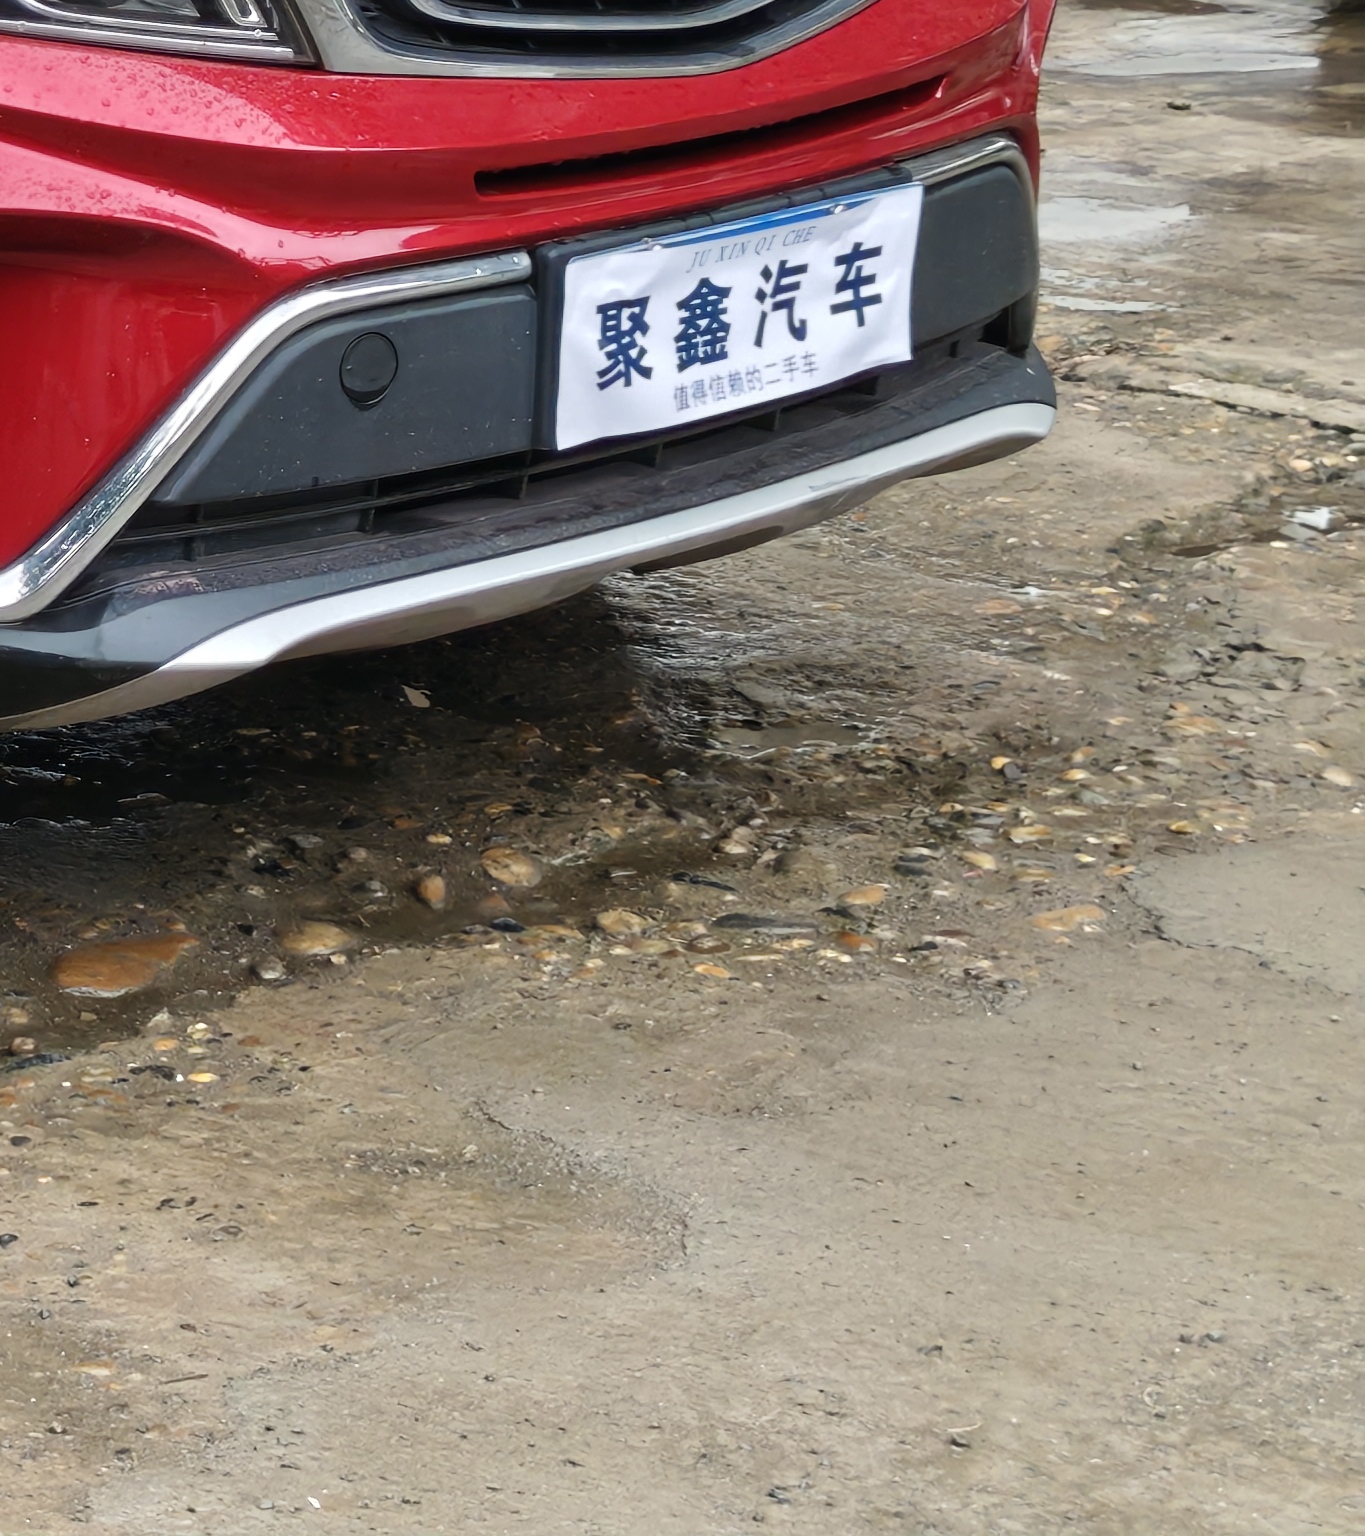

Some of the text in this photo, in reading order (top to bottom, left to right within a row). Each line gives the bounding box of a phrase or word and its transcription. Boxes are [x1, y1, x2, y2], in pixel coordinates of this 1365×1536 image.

[686, 225, 817, 273] JU XIN QI CHE
[596, 241, 883, 391] 聚鑫汽车
[673, 350, 820, 412] 值得信赖的二手车
